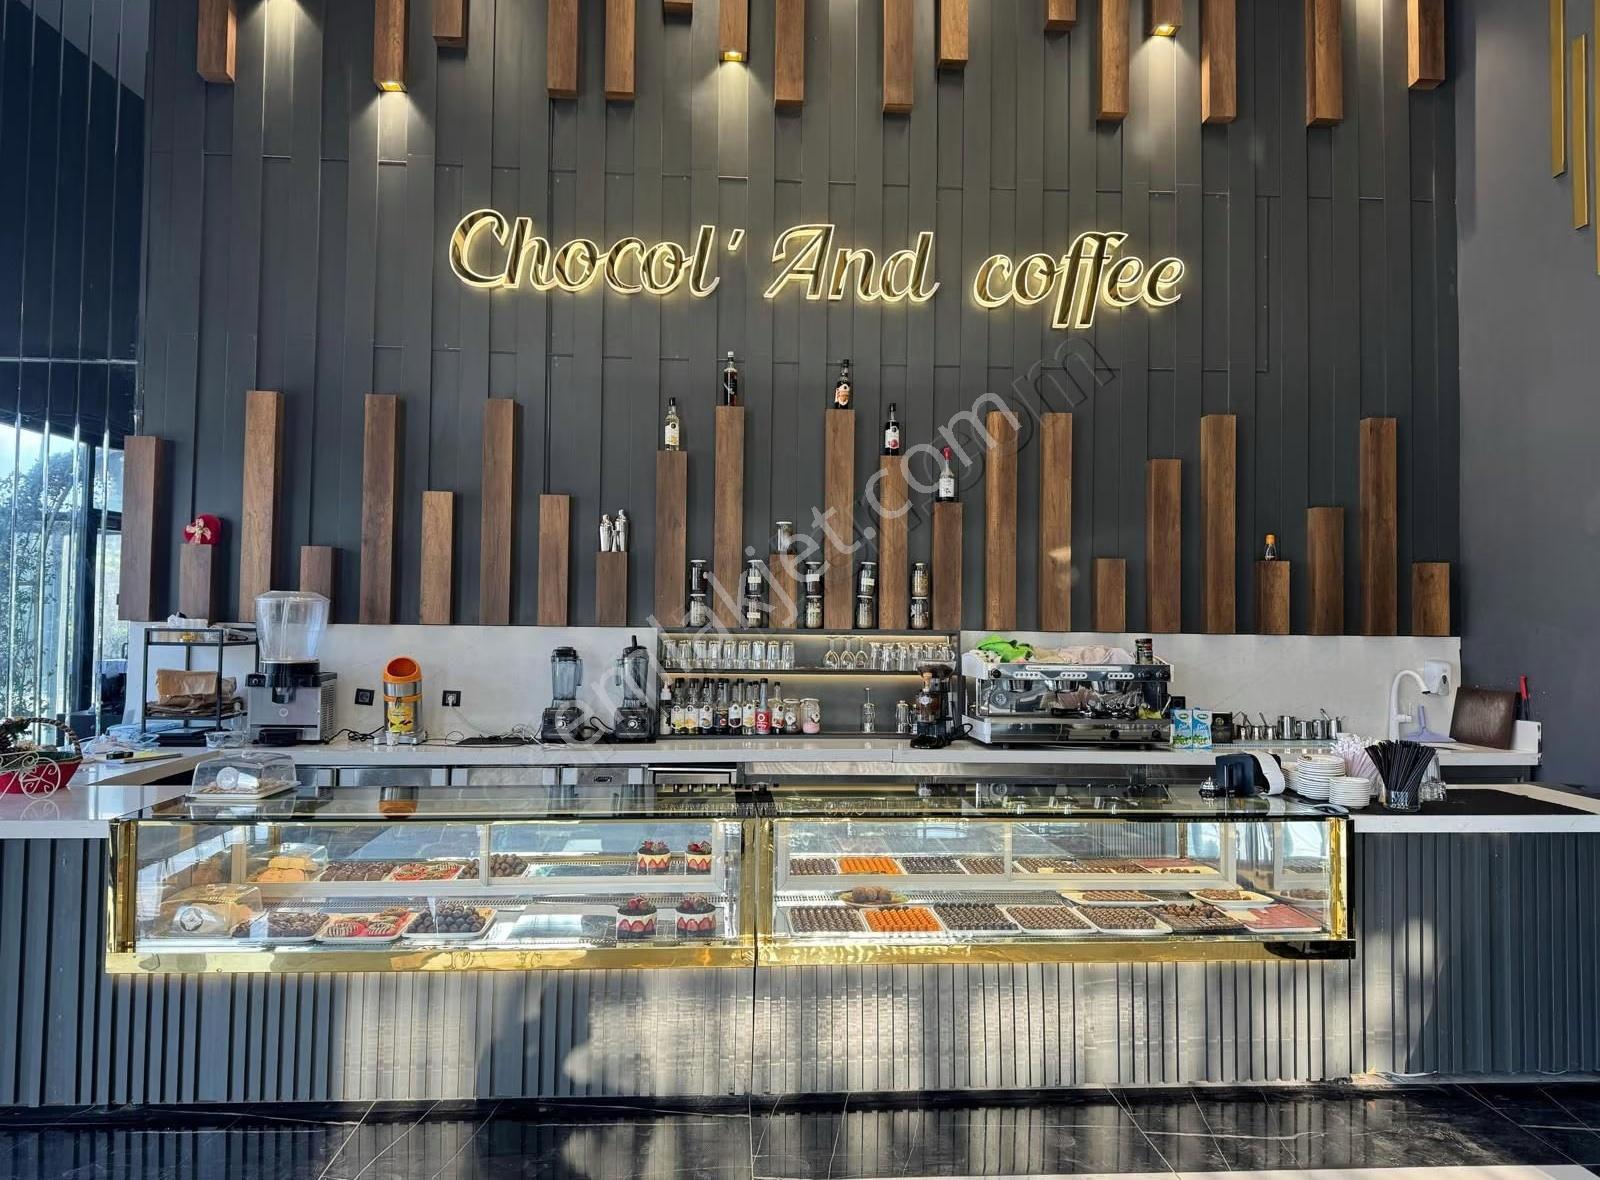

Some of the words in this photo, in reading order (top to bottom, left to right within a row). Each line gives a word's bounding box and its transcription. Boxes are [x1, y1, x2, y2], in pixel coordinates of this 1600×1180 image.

[449, 208, 745, 298] Chocol'
[764, 223, 940, 302] And
[974, 231, 1186, 328] coffee
